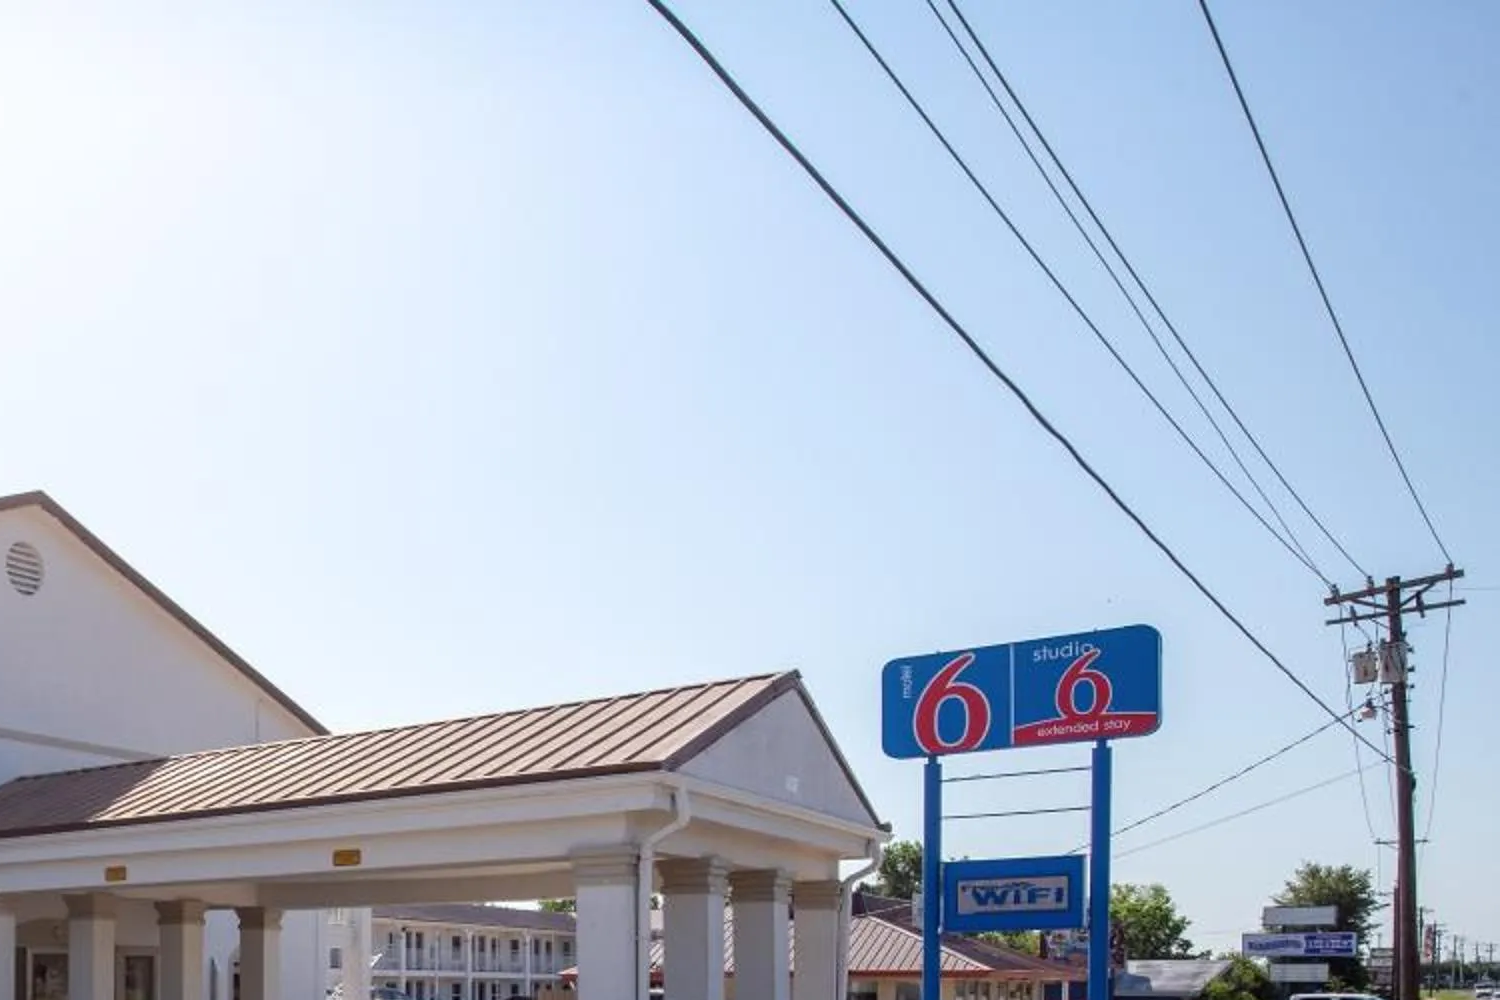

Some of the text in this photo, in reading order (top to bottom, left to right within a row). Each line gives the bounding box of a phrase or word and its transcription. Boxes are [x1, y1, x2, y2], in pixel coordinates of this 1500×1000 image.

[1033, 641, 1094, 662] studio
[913, 652, 991, 754] 6
[1055, 647, 1112, 718] 6
[1037, 719, 1131, 737] extended stay
